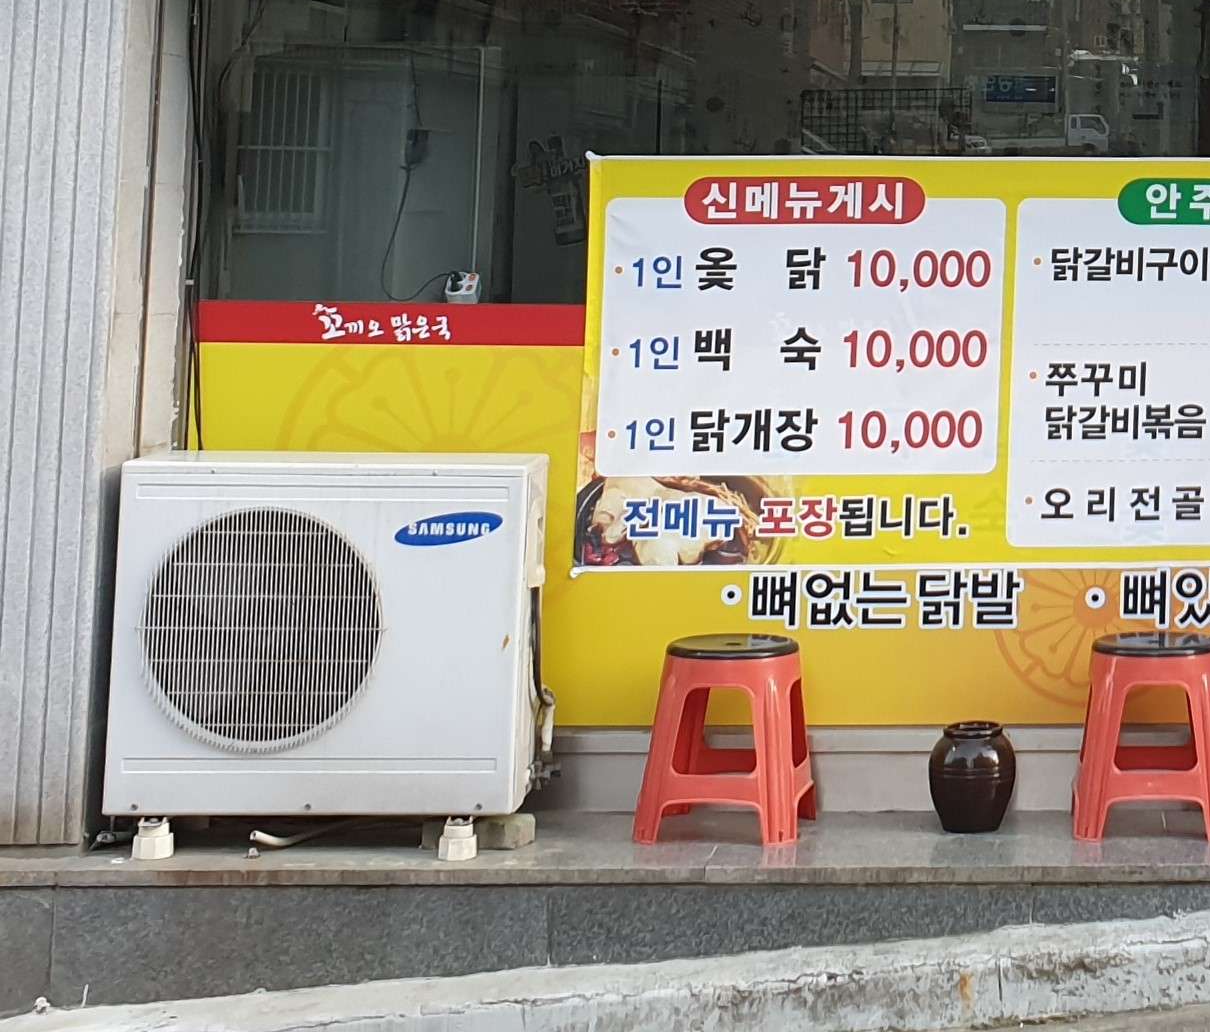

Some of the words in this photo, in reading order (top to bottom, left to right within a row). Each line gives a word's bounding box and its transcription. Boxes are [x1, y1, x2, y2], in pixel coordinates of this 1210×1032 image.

[701, 181, 903, 220] 신메뉴게시
[631, 256, 682, 289] 1인
[847, 250, 992, 292] 10,000
[1050, 246, 1210, 282] 닭갈비구이
[318, 314, 385, 340] 꼬끼오
[390, 312, 452, 342] 맑은국
[628, 336, 679, 370] 1인
[843, 329, 988, 373] 10,000
[1044, 361, 1148, 397] 쭈꾸미
[626, 418, 676, 451] 1인
[689, 408, 819, 453] 닭개장
[838, 409, 983, 454] 10,000
[1044, 404, 1208, 440] 닭갈비볶음
[408, 520, 491, 537] SAMSUNG
[623, 497, 742, 538] 전메뉴
[757, 495, 969, 537] 포장됩니다.
